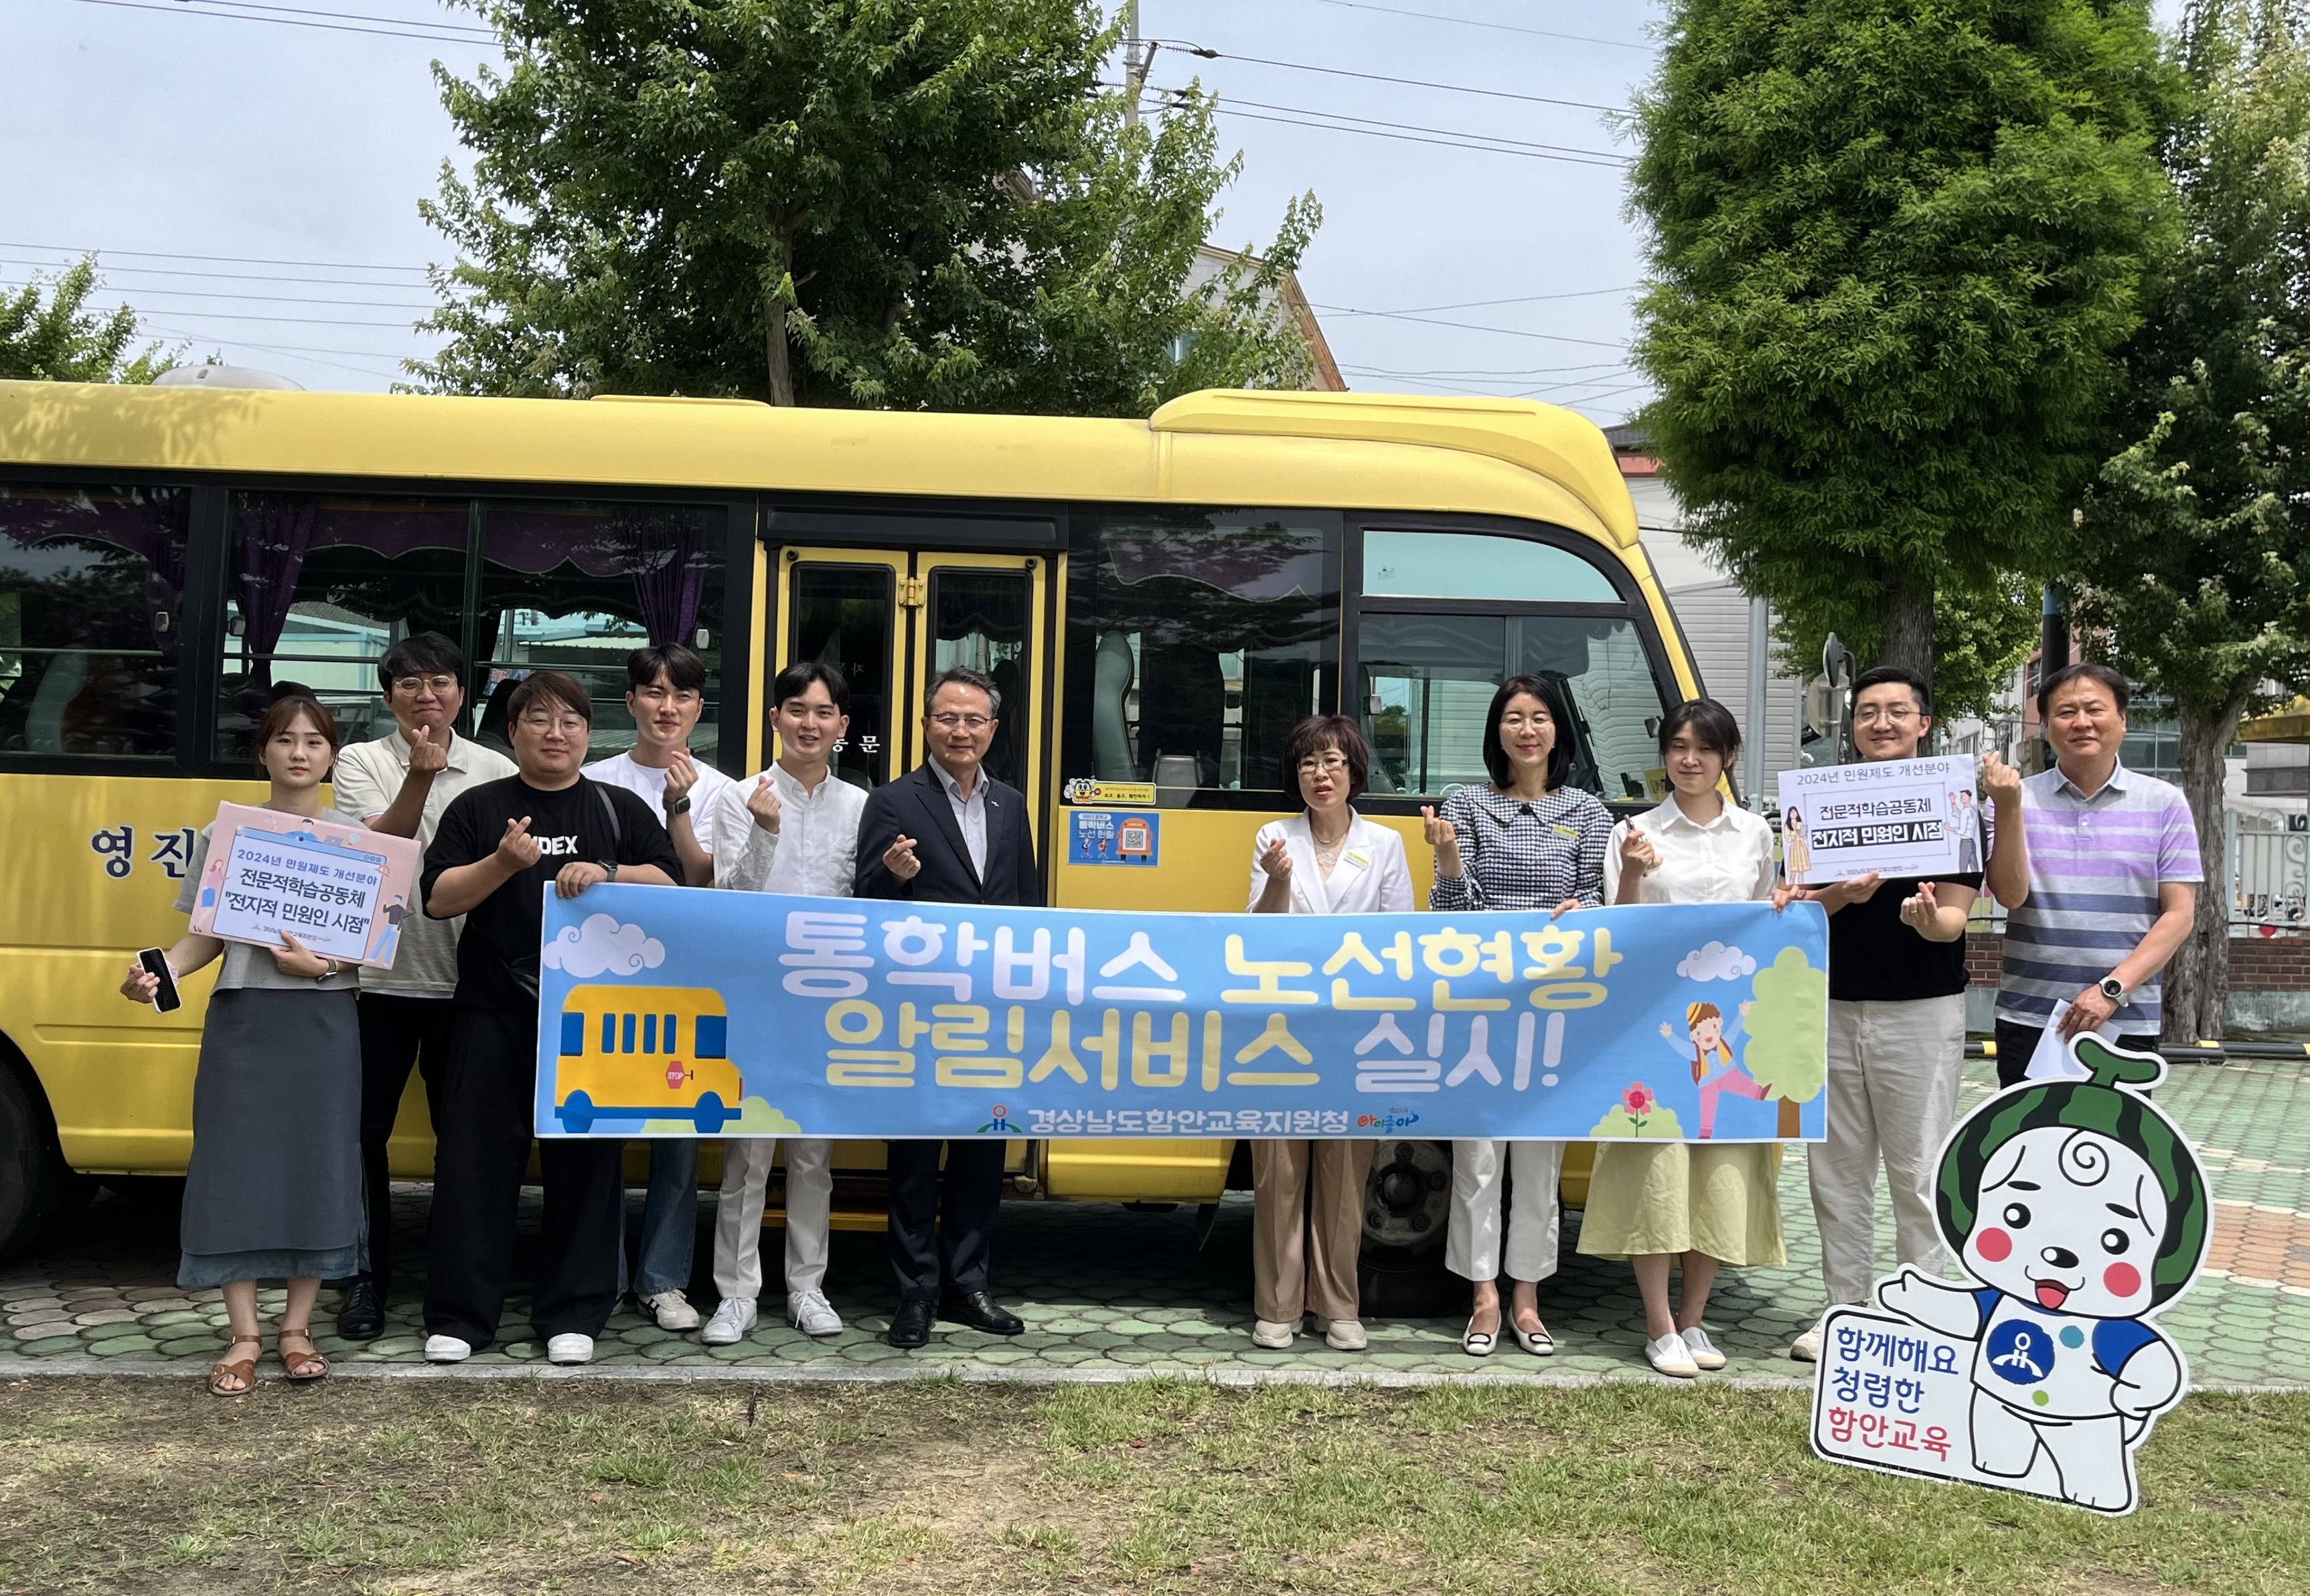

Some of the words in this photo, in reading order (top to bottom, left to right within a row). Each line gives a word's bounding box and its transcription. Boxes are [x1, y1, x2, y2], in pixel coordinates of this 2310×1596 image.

[1797, 772, 1839, 785] 2024년
[1845, 767, 1894, 781] 민원제도
[1899, 761, 1950, 777] 개선분야
[1820, 798, 1931, 820] 전문적학습공동체
[533, 835, 578, 855] DEX
[1079, 829, 1096, 838] 노선
[1813, 828, 1858, 848] 전지적
[1861, 823, 1908, 844] 민원인
[1912, 821, 1942, 841] 시점
[238, 850, 282, 866] 2024년
[286, 858, 330, 876] 민원제도
[333, 868, 378, 886] 개선분야
[240, 868, 366, 908] 전문적학습공동체
[225, 891, 279, 918] "전지적
[282, 902, 329, 927] 민원인
[331, 912, 370, 935] 시점"
[778, 910, 1186, 1006] 통학버스
[1221, 924, 1623, 1012] 노선현황
[825, 999, 1321, 1092] 알림서비스
[1355, 1011, 1565, 1093] 실시!
[668, 1072, 684, 1080] STOP
[1027, 1109, 1349, 1134] 경상남도함안교육지원청
[1837, 1326, 1958, 1375] 함께해요
[1832, 1366, 1924, 1415] 청렴한
[1828, 1407, 1952, 1462] 함안교육
